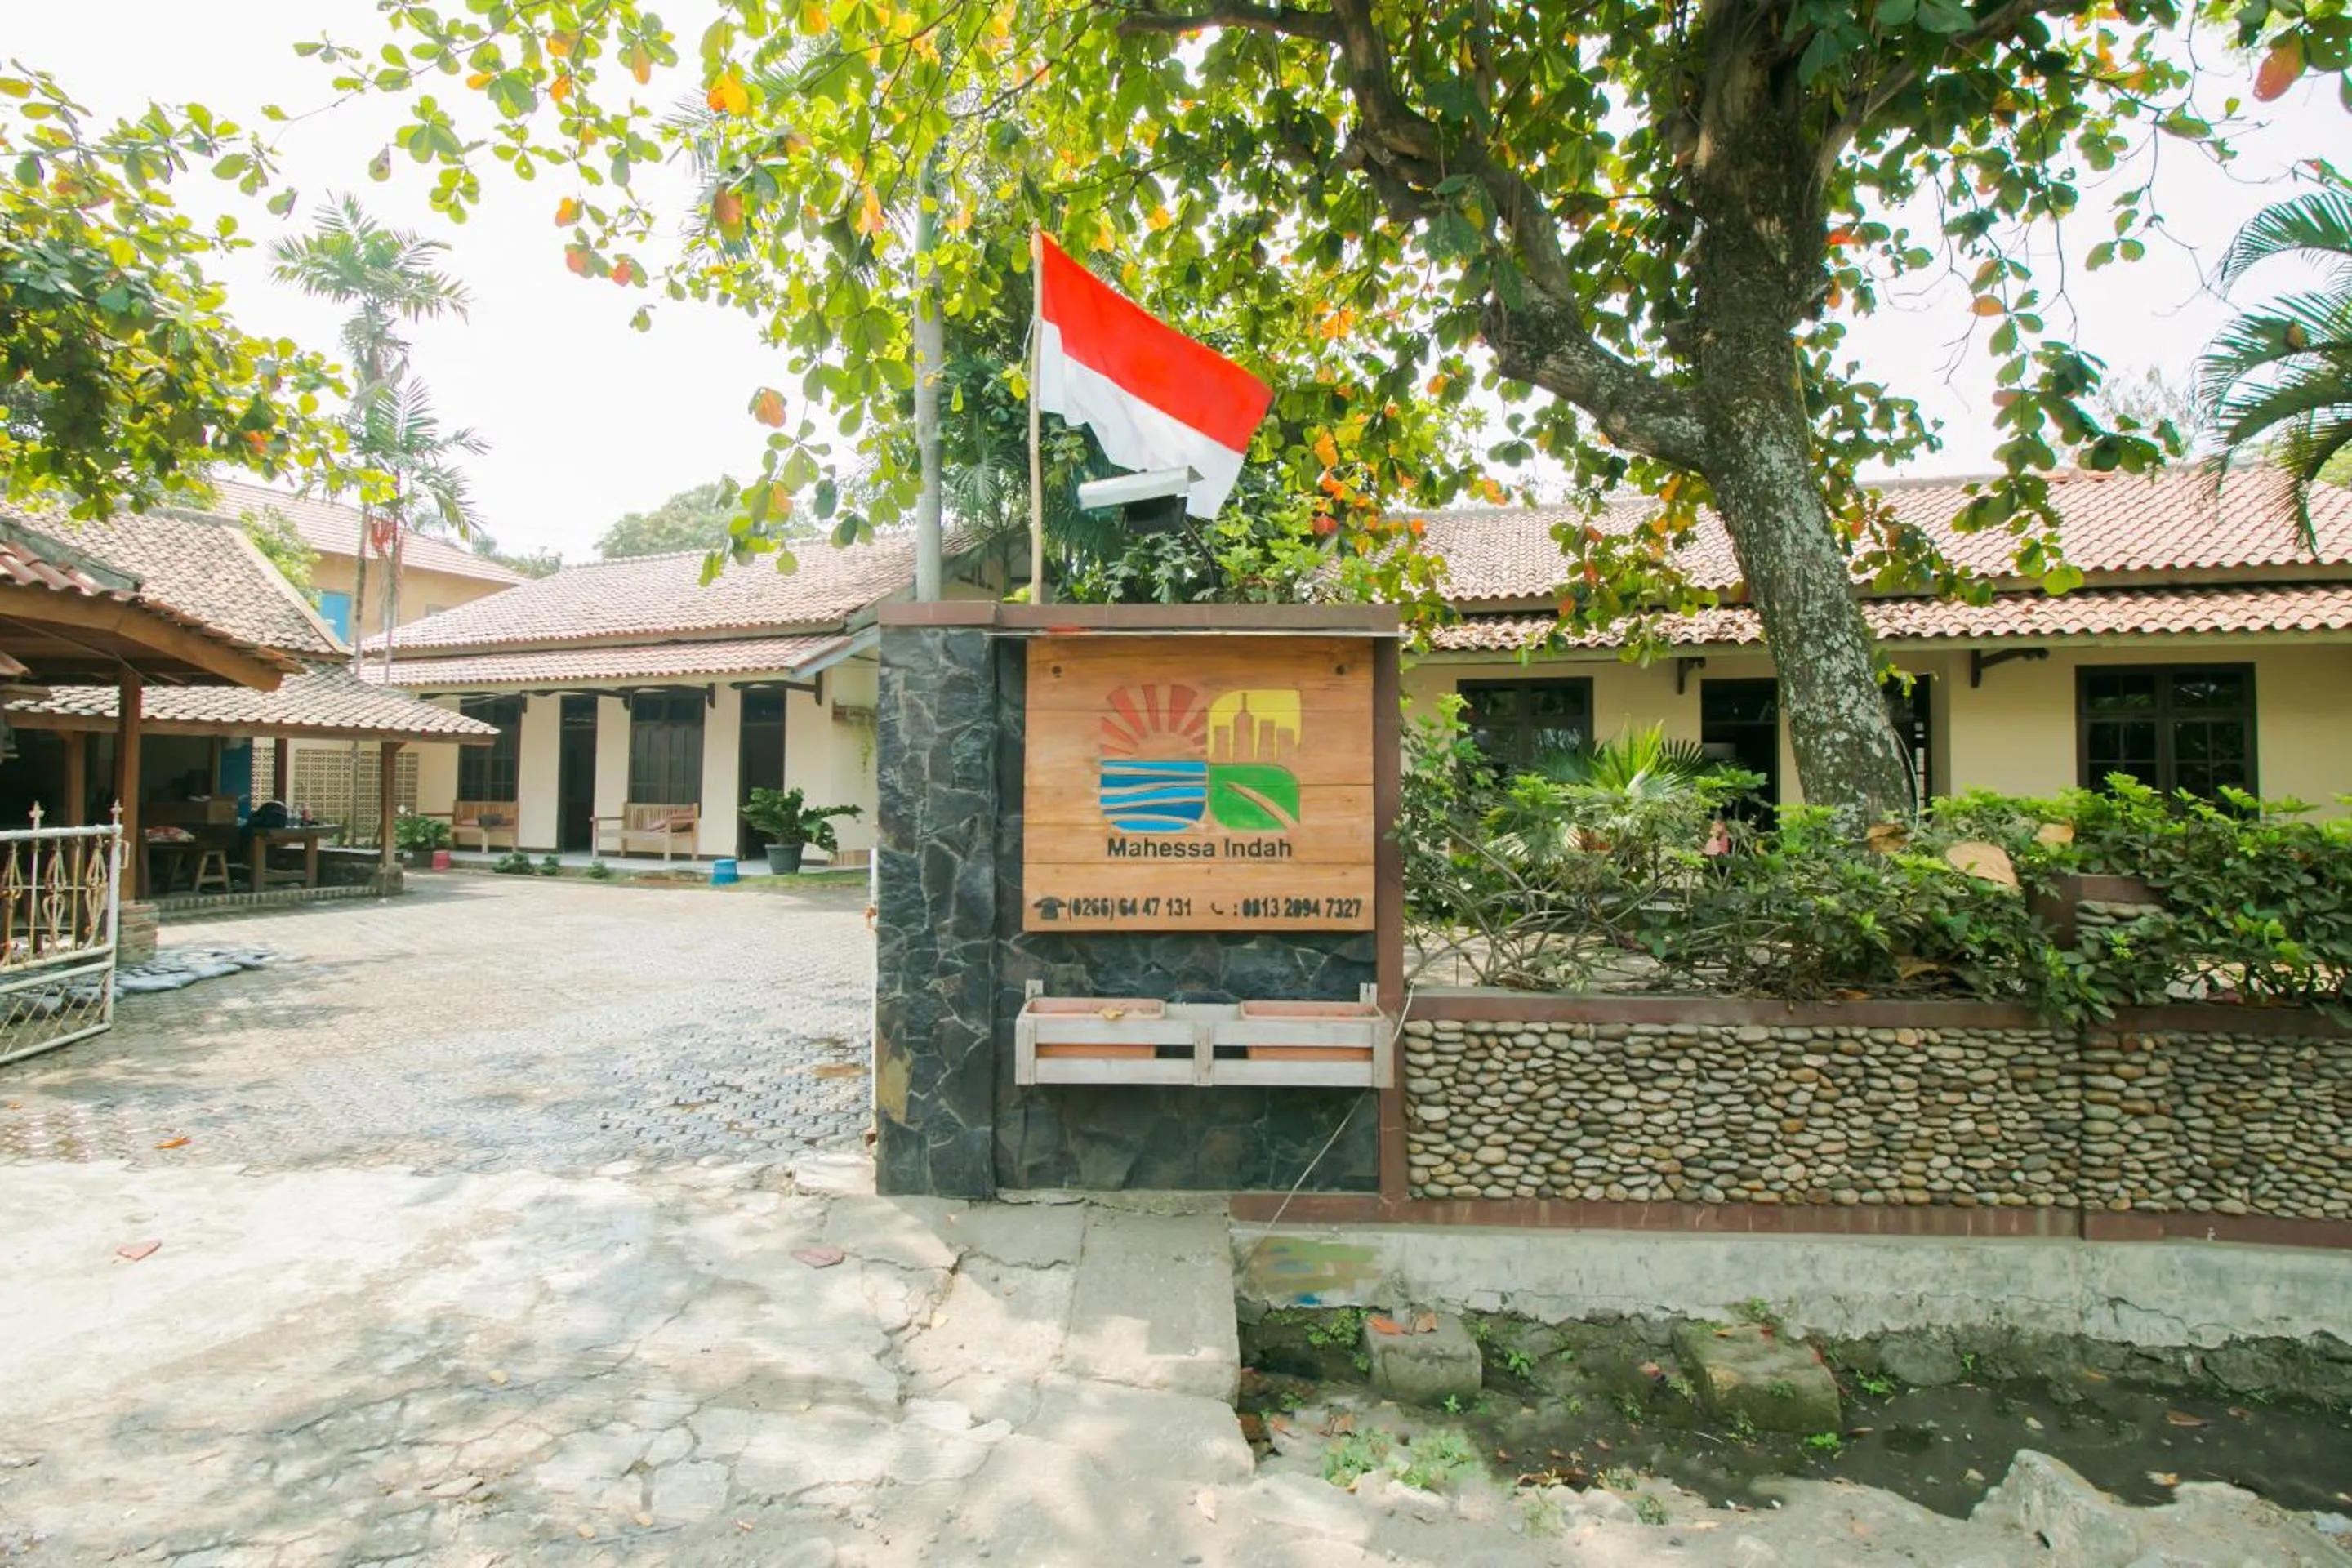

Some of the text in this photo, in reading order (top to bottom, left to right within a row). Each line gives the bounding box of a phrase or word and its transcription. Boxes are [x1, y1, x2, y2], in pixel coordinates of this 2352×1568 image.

[1107, 837, 1292, 858] Mahessa Indah
[1142, 898, 1160, 916] 47
[1166, 898, 1191, 916] 131
[1242, 898, 1280, 917] 0813
[1325, 898, 1361, 918] 7327
